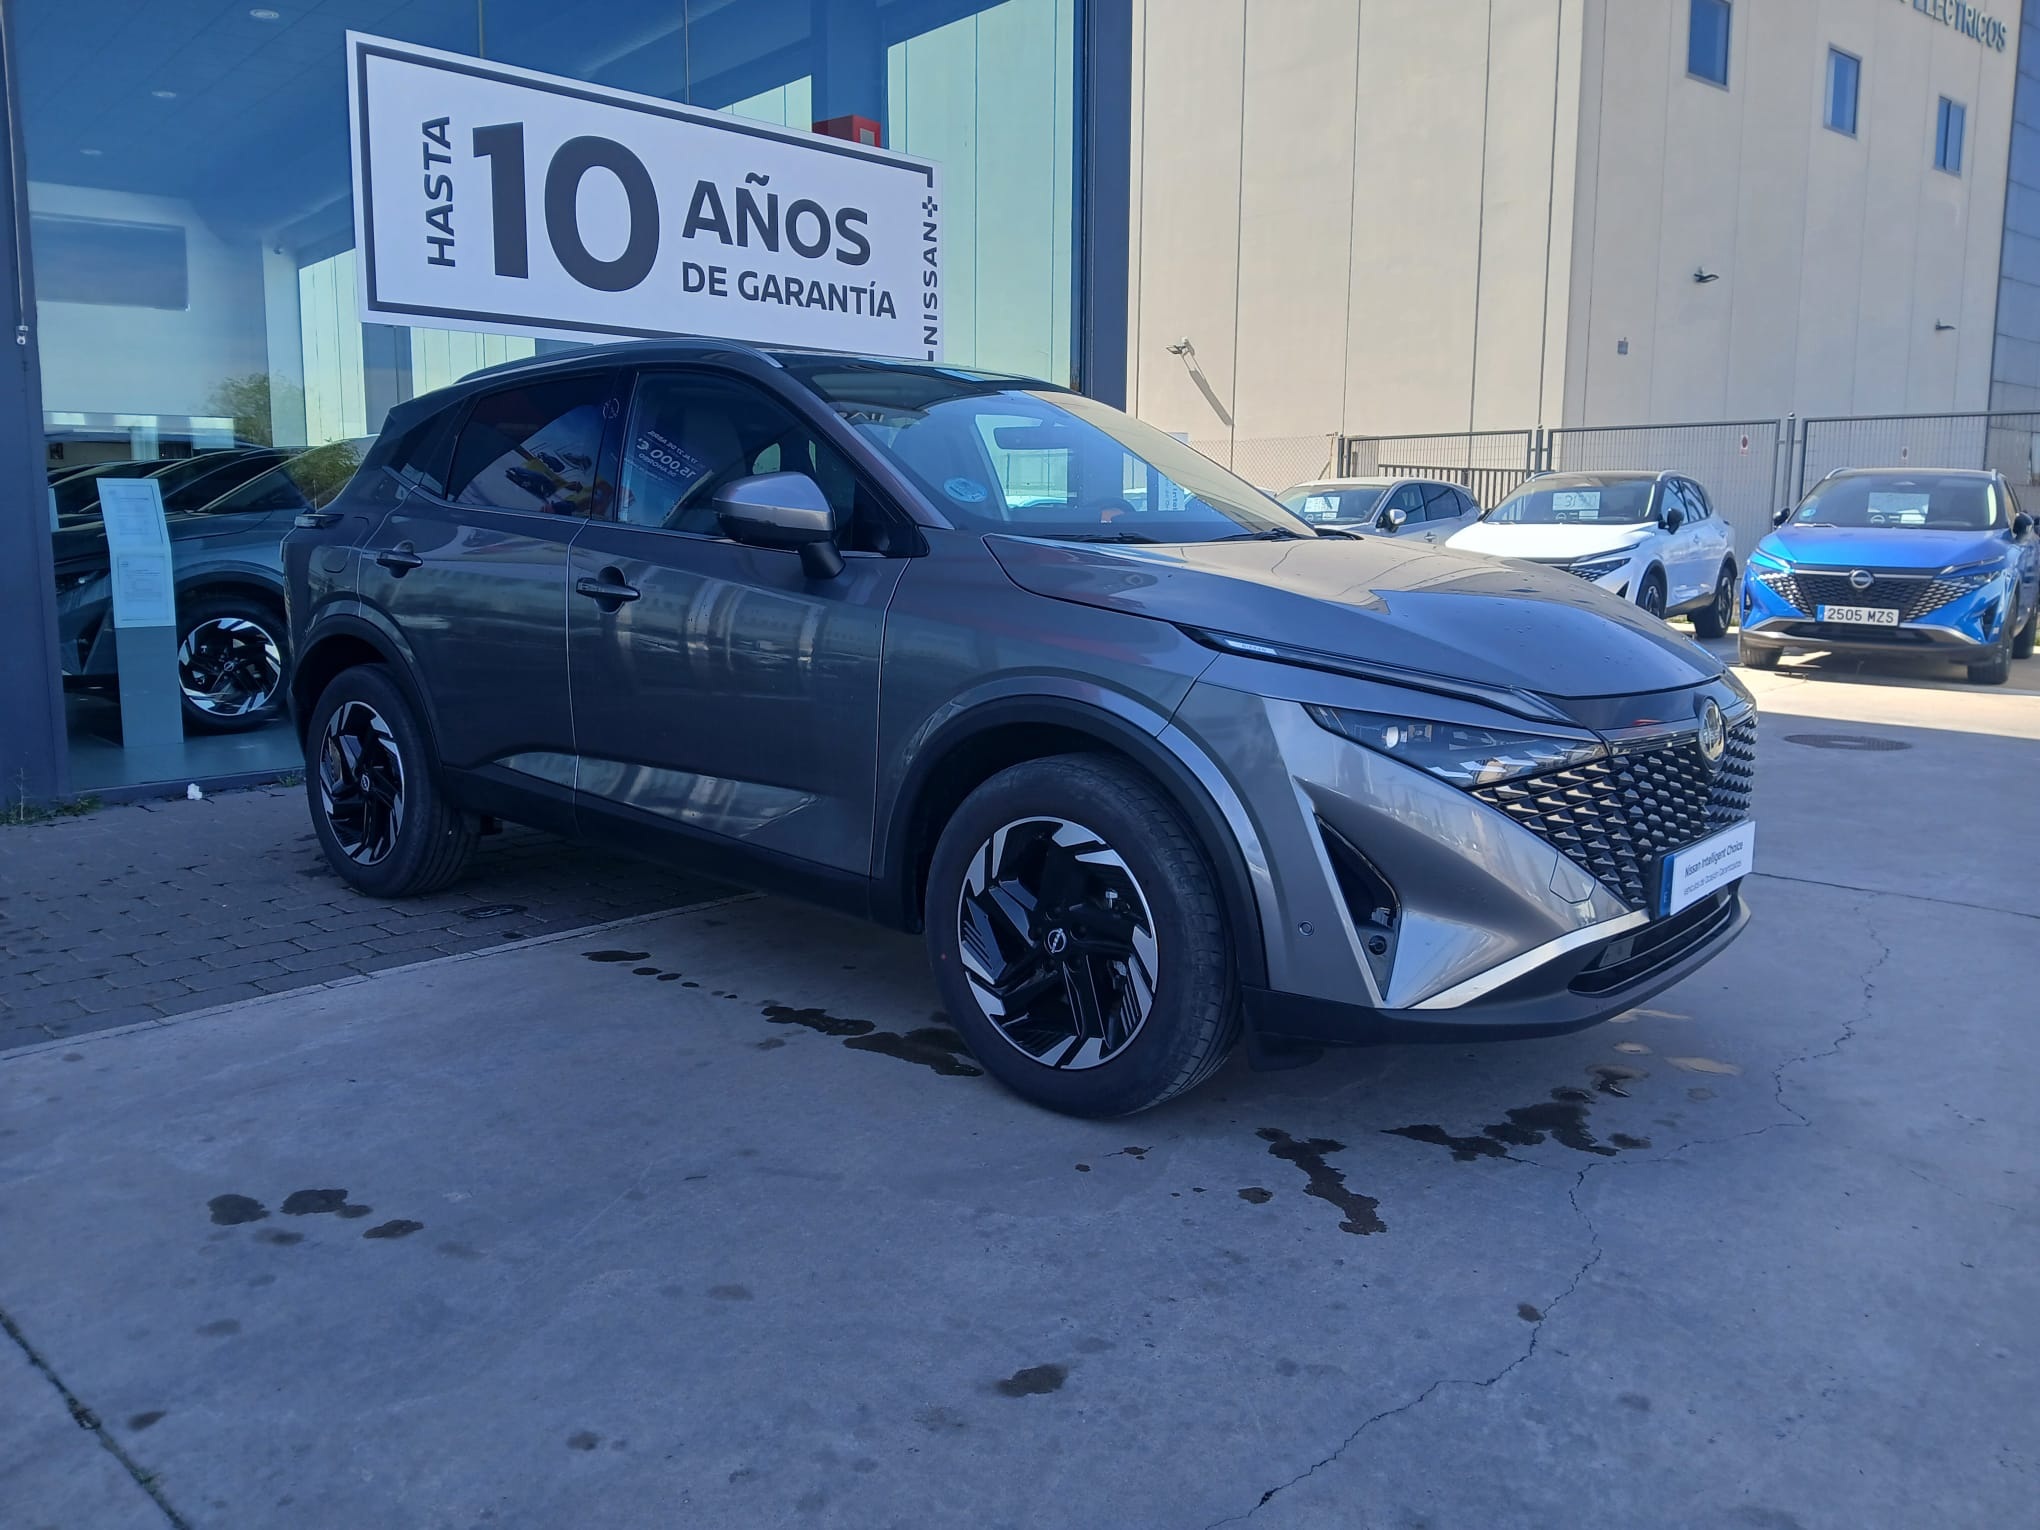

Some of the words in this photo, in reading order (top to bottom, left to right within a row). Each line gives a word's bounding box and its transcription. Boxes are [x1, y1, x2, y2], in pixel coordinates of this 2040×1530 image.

[422, 117, 455, 267] HASTA
[473, 122, 659, 292] 10
[682, 172, 871, 266] AÑOS
[683, 262, 727, 297] DE
[738, 271, 896, 319] GARANTÍA
[1827, 608, 1863, 621] 2505
[1867, 610, 1894, 623] MZS
[1684, 861, 1701, 878] Nissan
[1701, 848, 1727, 868] Intelligent
[1727, 840, 1744, 856] Choice
